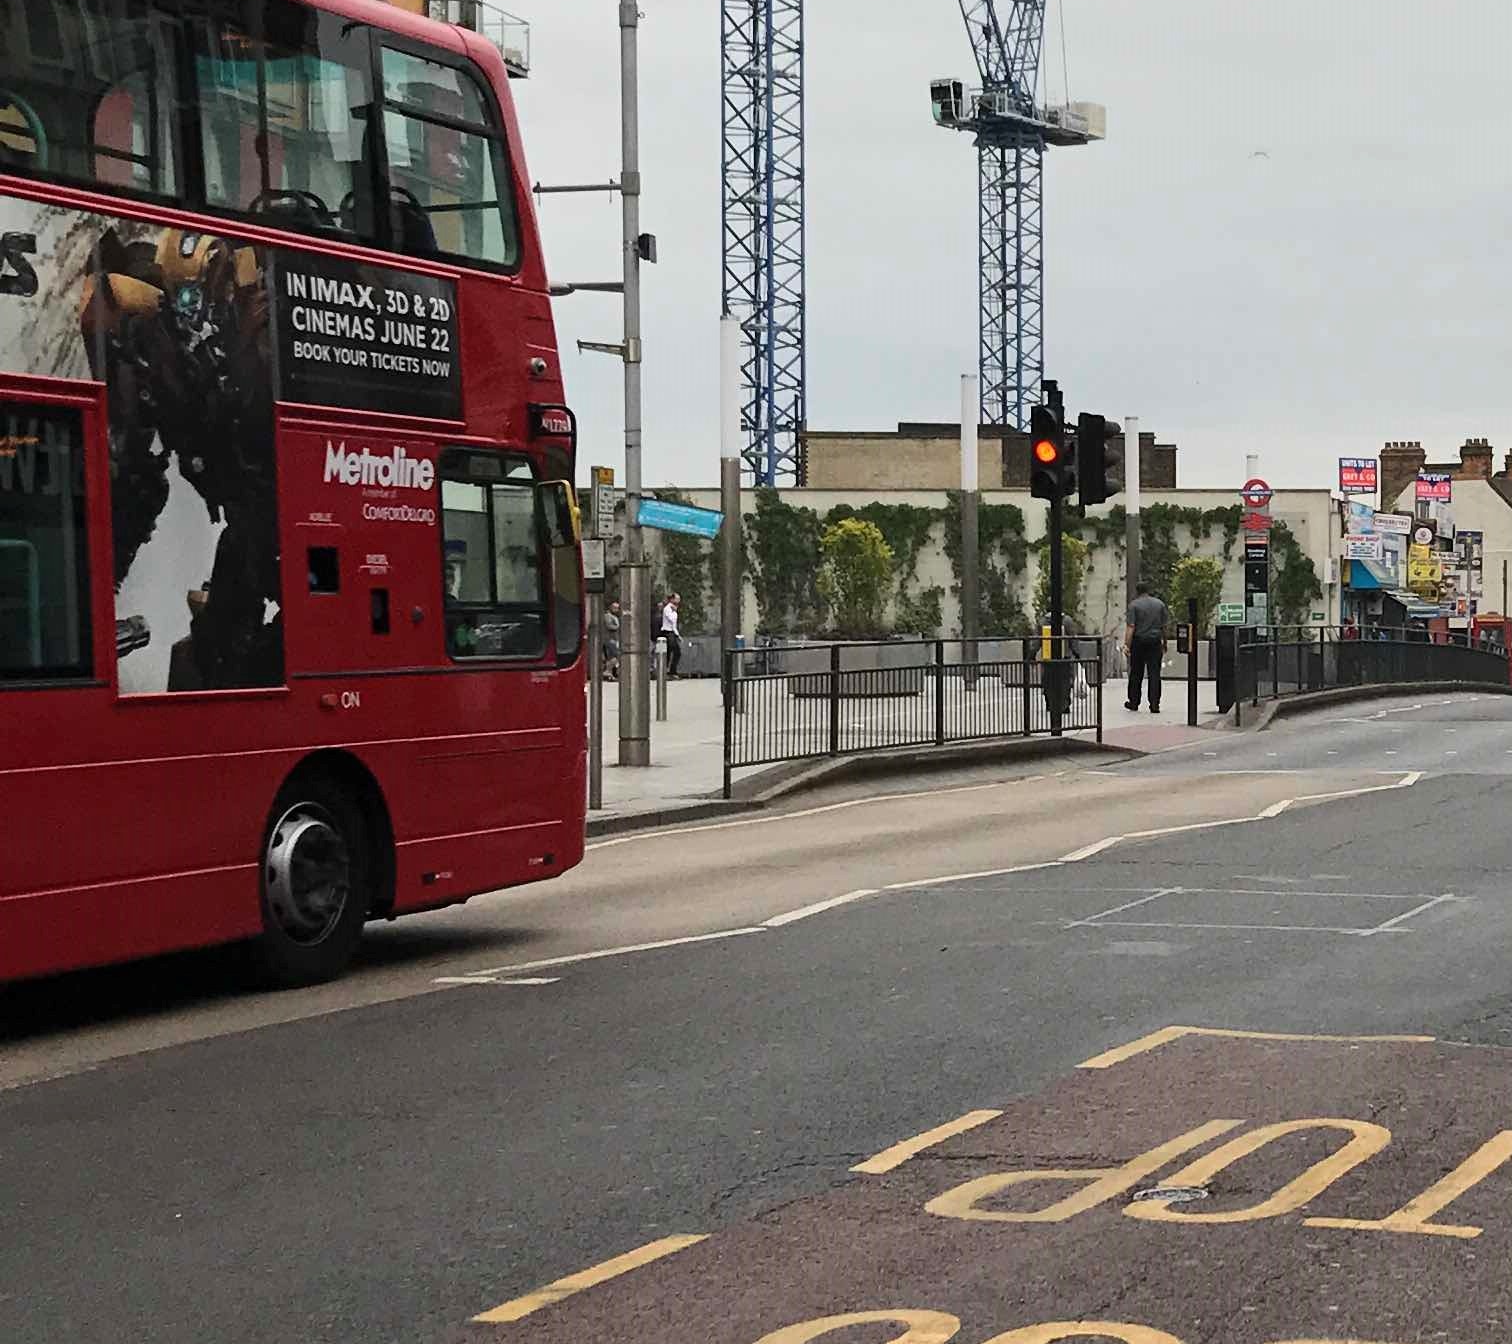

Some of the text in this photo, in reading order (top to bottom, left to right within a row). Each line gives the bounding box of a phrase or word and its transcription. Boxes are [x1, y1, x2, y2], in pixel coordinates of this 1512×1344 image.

[286, 272, 450, 322] IN IMAX, 3D & 2D
[292, 306, 450, 352] CINEMAS JUNE 22
[294, 341, 450, 378] BOOK YOUR TICKETS NOW
[323, 439, 435, 491] Metroline
[341, 692, 361, 708] ON
